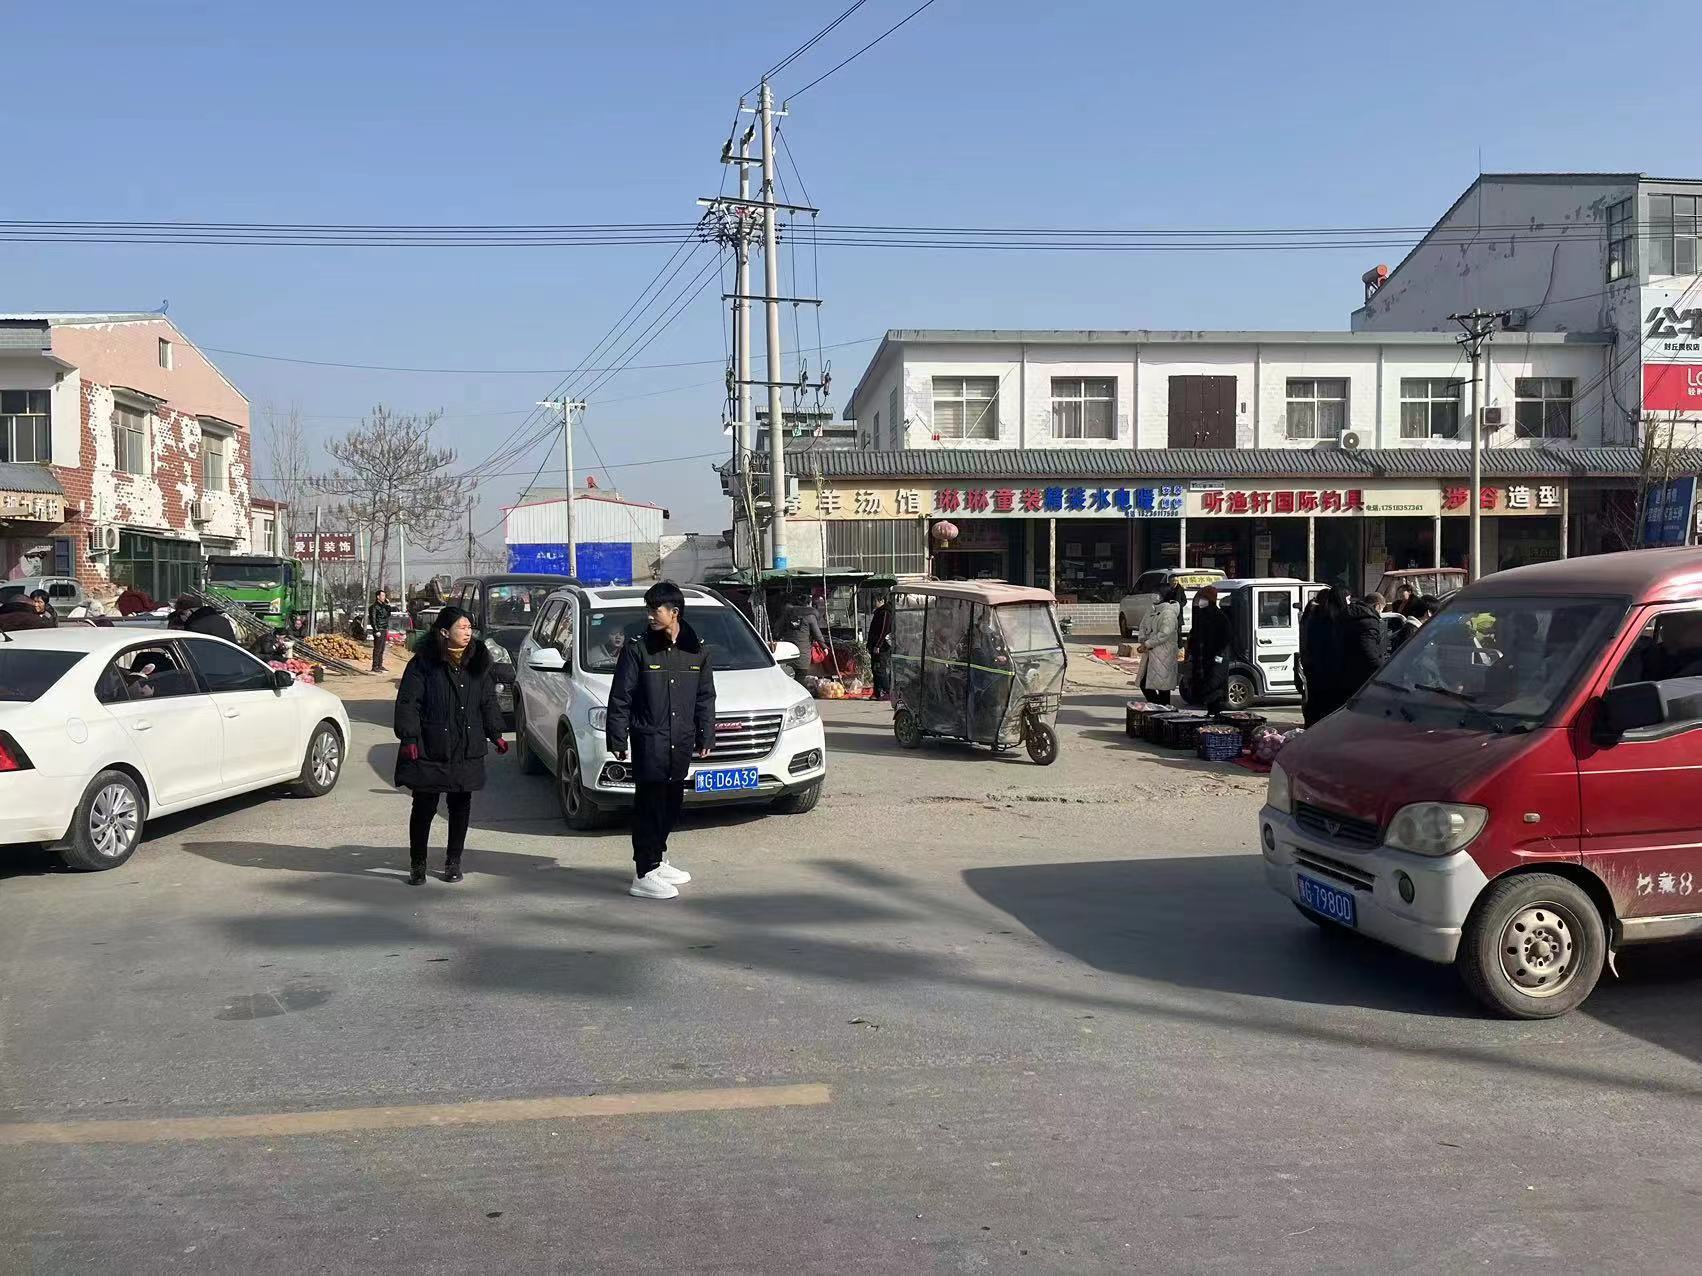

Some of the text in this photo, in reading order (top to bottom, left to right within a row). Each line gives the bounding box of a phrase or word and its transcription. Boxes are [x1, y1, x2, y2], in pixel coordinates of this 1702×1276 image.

[1664, 343, 1700, 351] 封丘授权店
